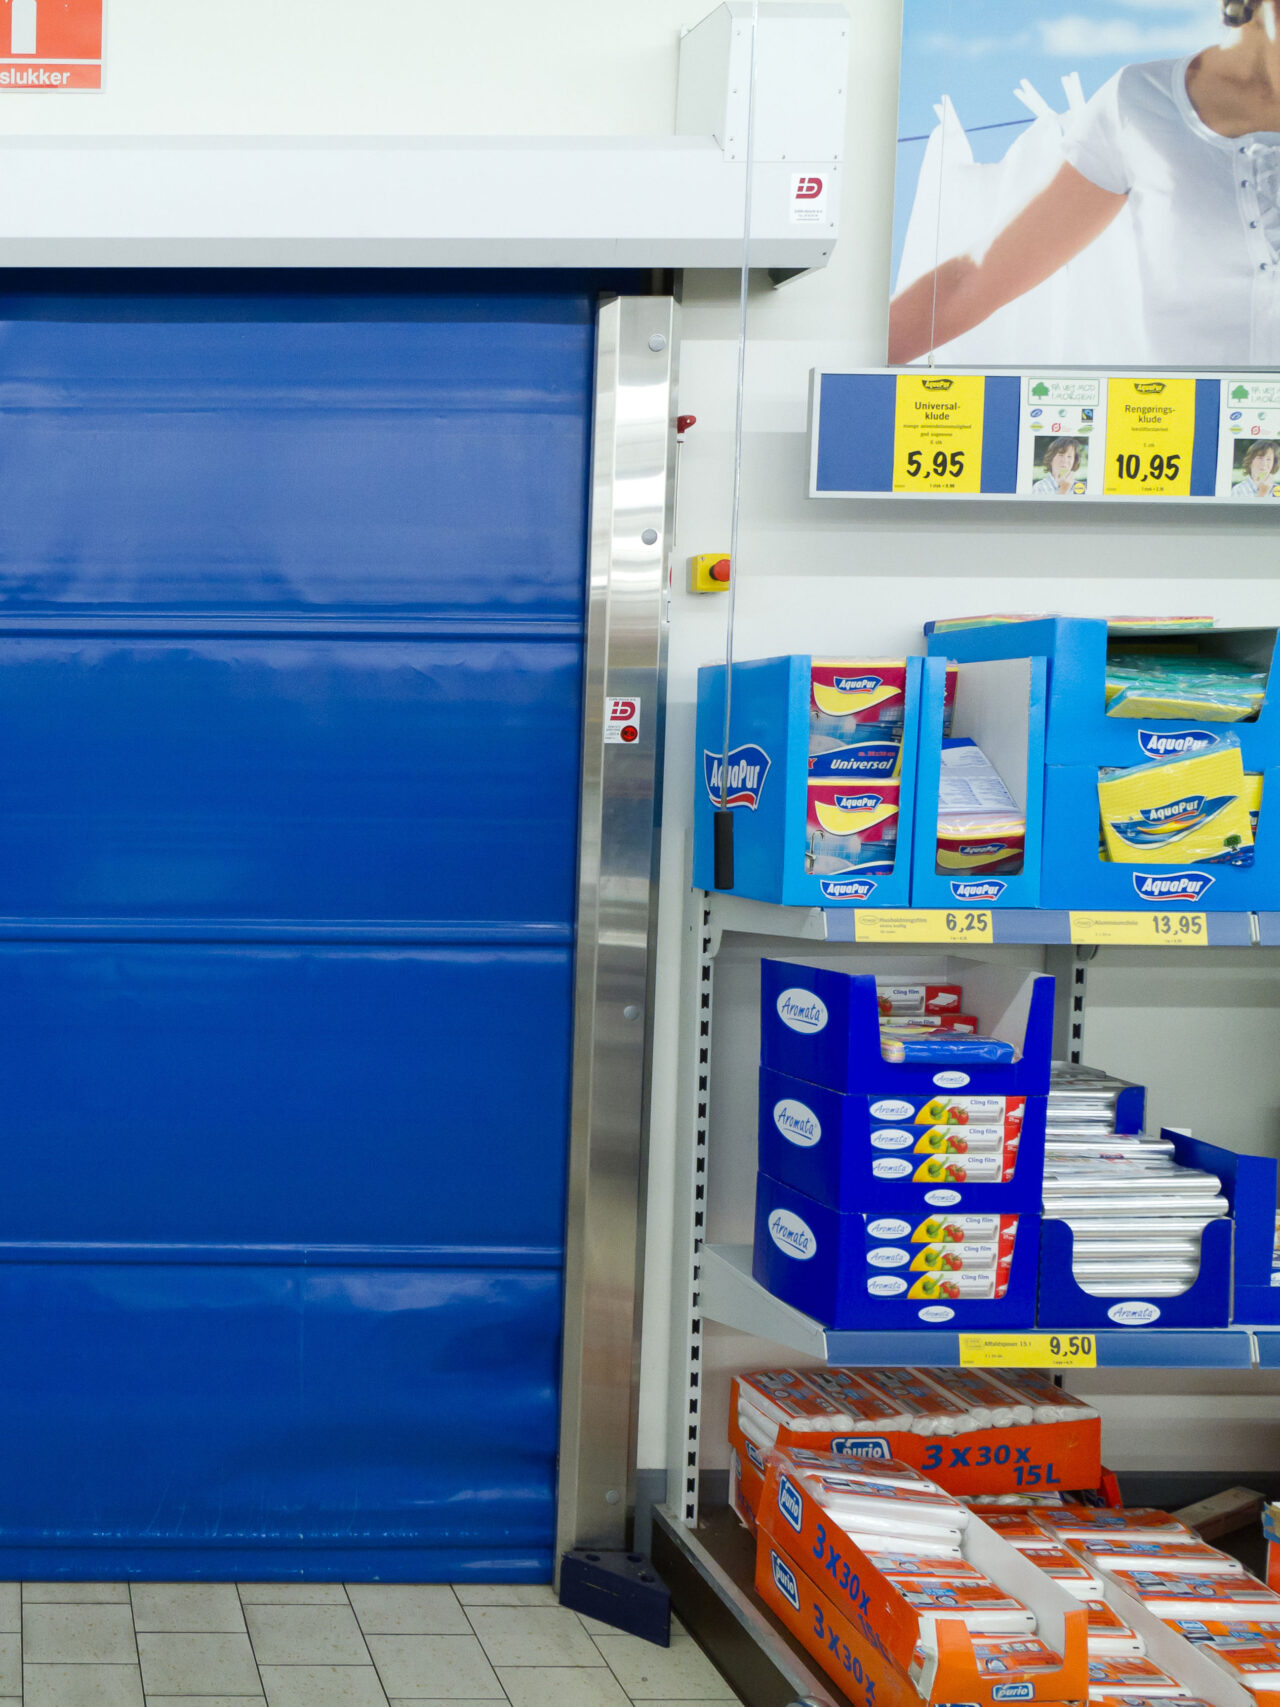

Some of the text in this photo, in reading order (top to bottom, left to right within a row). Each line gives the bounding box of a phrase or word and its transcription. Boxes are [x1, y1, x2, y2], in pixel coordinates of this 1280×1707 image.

[914, 401, 961, 410] Universal-
[1125, 404, 1175, 415] Rengørings-
[925, 412, 950, 420] klude
[907, 450, 965, 478] 5,95
[1116, 454, 1181, 482] 10,95
[839, 679, 877, 690] AquaPur
[830, 758, 894, 769] Universal
[840, 797, 877, 809] AquaPur
[1149, 800, 1199, 820] AquaPur
[827, 883, 869, 896] AquaPur
[957, 884, 999, 897] AquaPur
[1141, 877, 1203, 895] AquaPur
[945, 912, 988, 933] 6,25
[1153, 915, 1202, 935] 13,95
[781, 996, 821, 1021] Aromata
[875, 1104, 908, 1115] Aromata
[778, 1107, 814, 1137] Aromata
[874, 1133, 908, 1144] Aromata
[873, 1162, 907, 1173] Aromata
[772, 1216, 809, 1250] Aromata
[872, 1223, 905, 1233] Aromata
[871, 1252, 904, 1262] Aromata
[869, 1280, 901, 1290] Aromata
[1113, 1307, 1154, 1319] Aromata
[1049, 1336, 1092, 1357] 9,50
[781, 1489, 799, 1518] purio
[775, 1564, 795, 1595] purio
[998, 1686, 1028, 1698] purio
